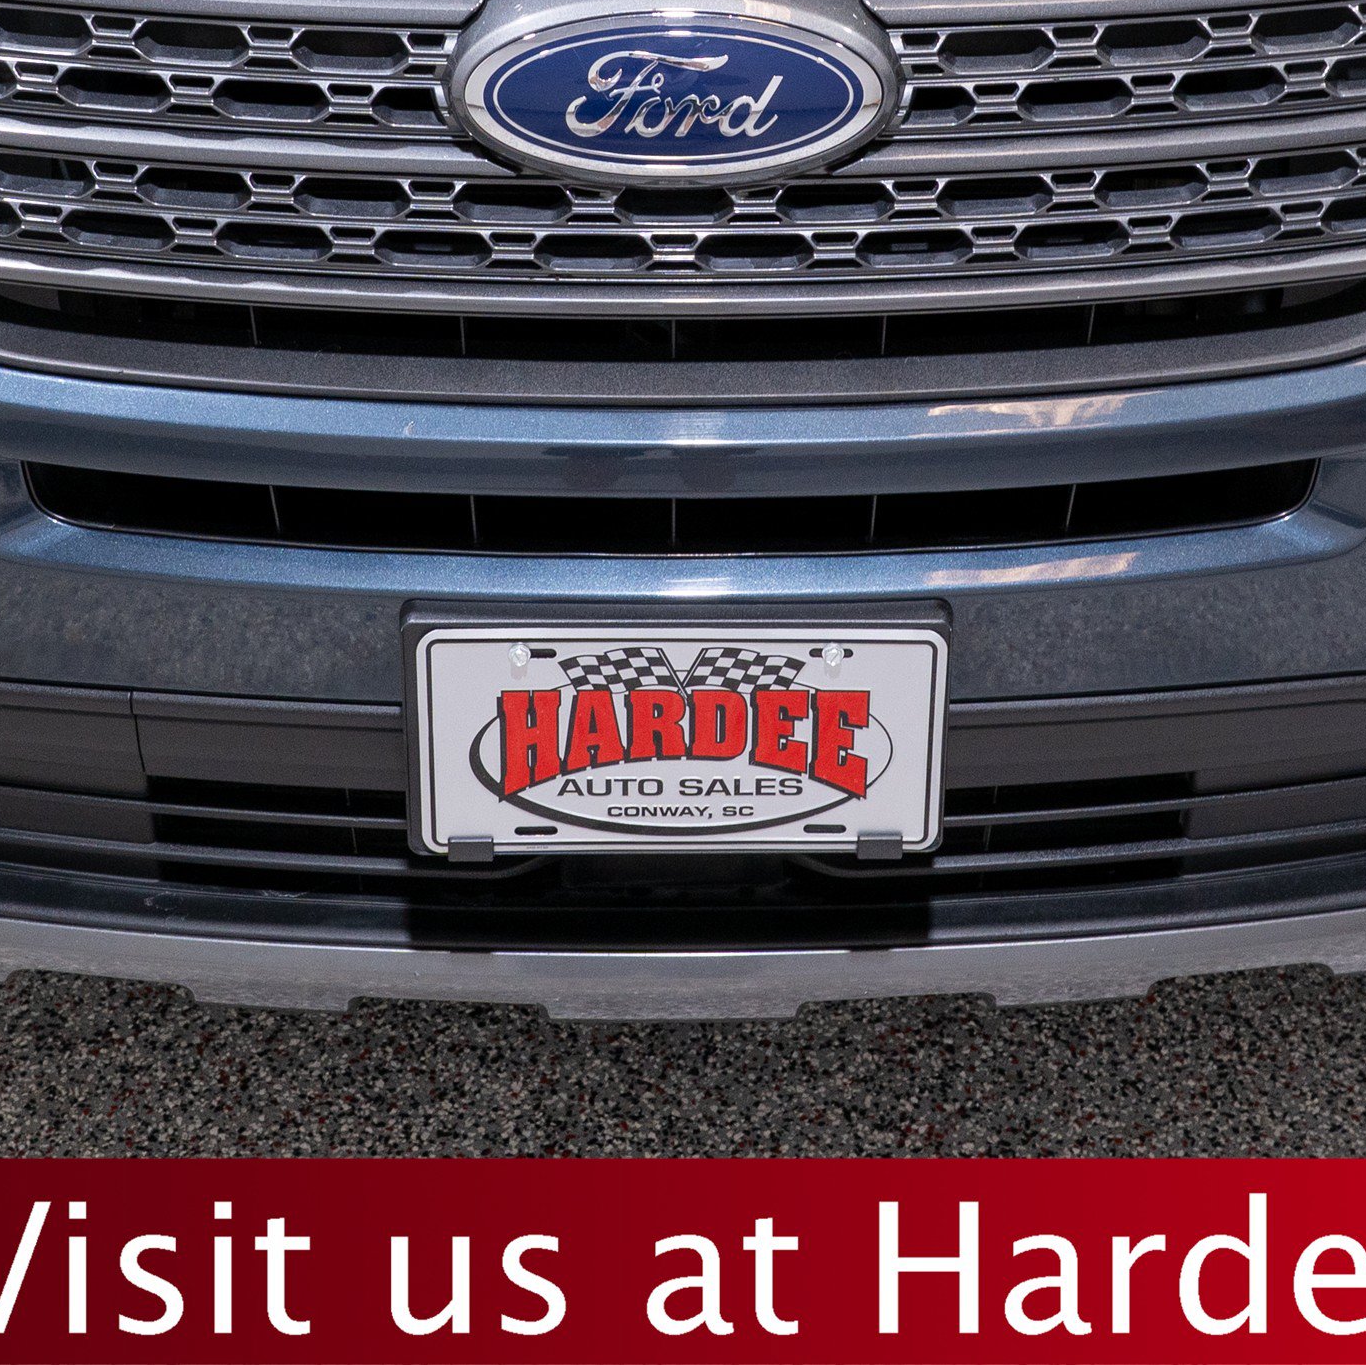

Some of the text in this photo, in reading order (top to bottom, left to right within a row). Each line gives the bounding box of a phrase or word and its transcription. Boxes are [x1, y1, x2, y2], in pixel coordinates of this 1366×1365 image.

[565, 50, 784, 138] Ford
[498, 689, 871, 800] HARDEE
[557, 777, 804, 797] AUTO SALES
[607, 805, 755, 820] CONWAY, SC
